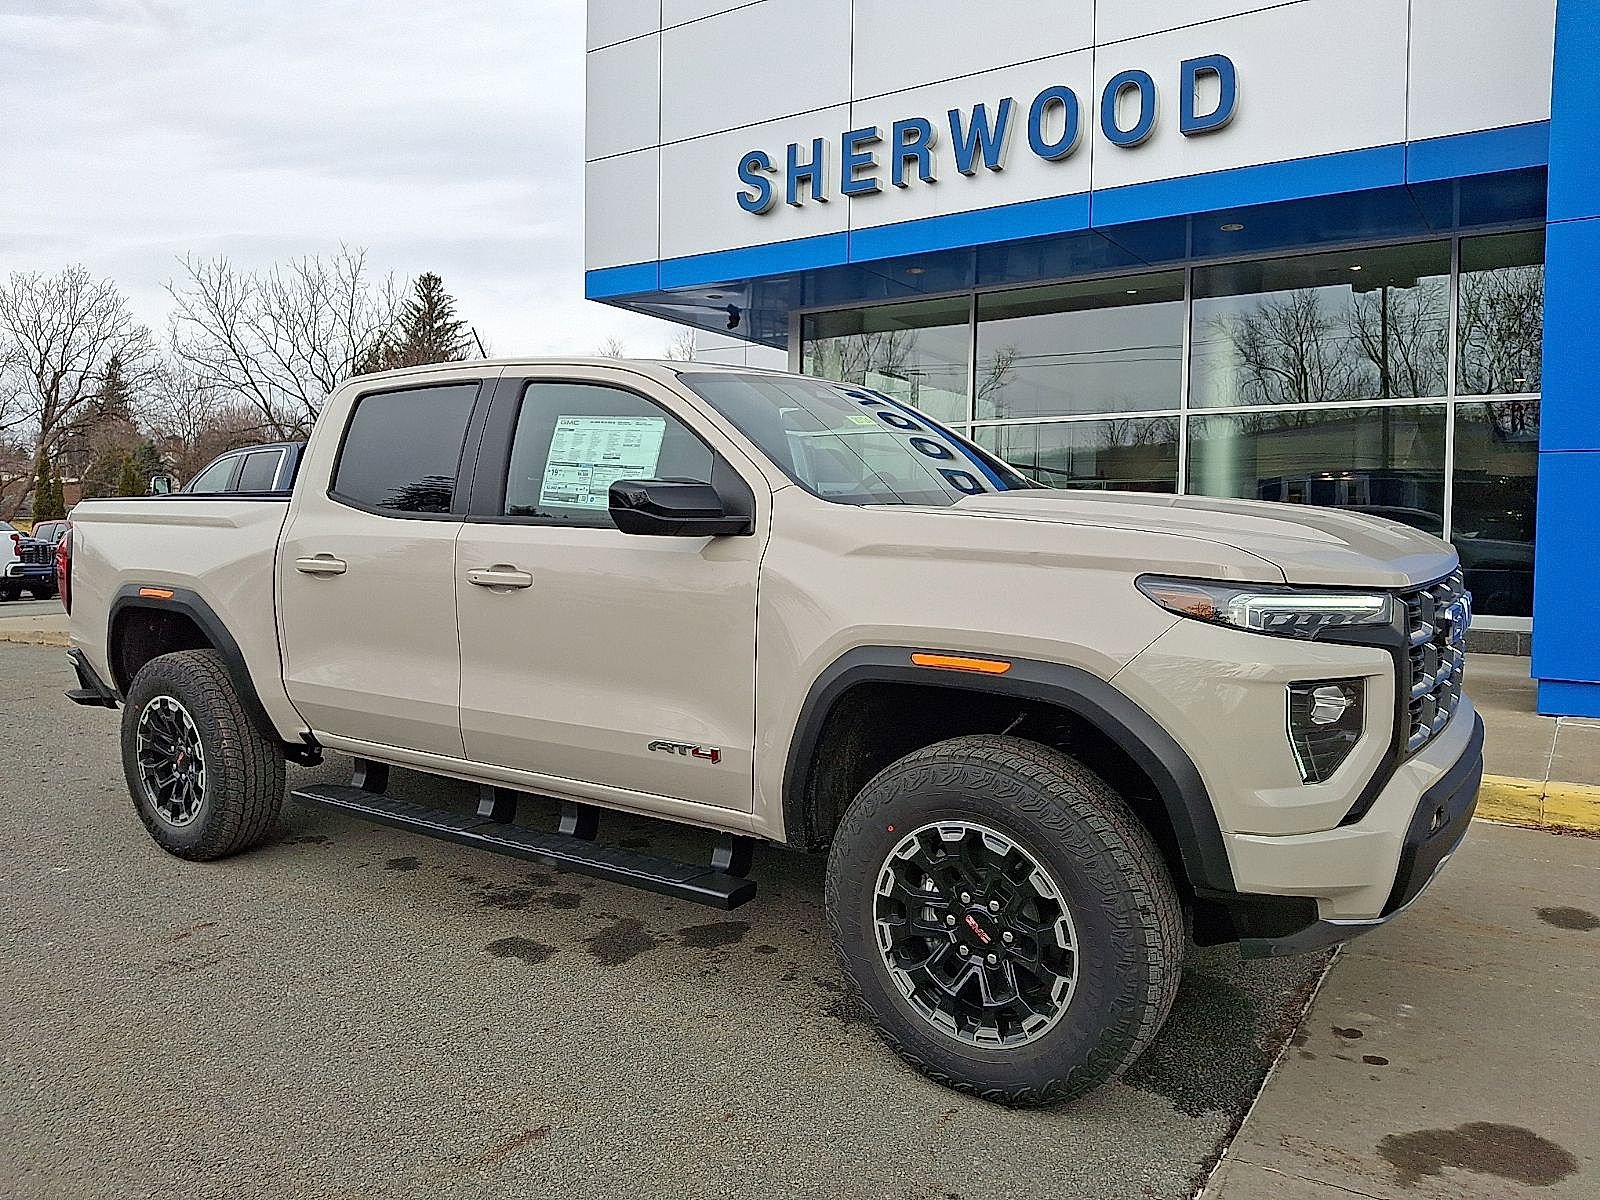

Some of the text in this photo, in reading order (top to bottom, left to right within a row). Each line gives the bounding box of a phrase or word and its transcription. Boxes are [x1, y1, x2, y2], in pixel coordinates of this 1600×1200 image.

[737, 54, 1239, 214] SHERWOOD
[647, 739, 722, 765] AT4
[965, 914, 992, 944] GMC
